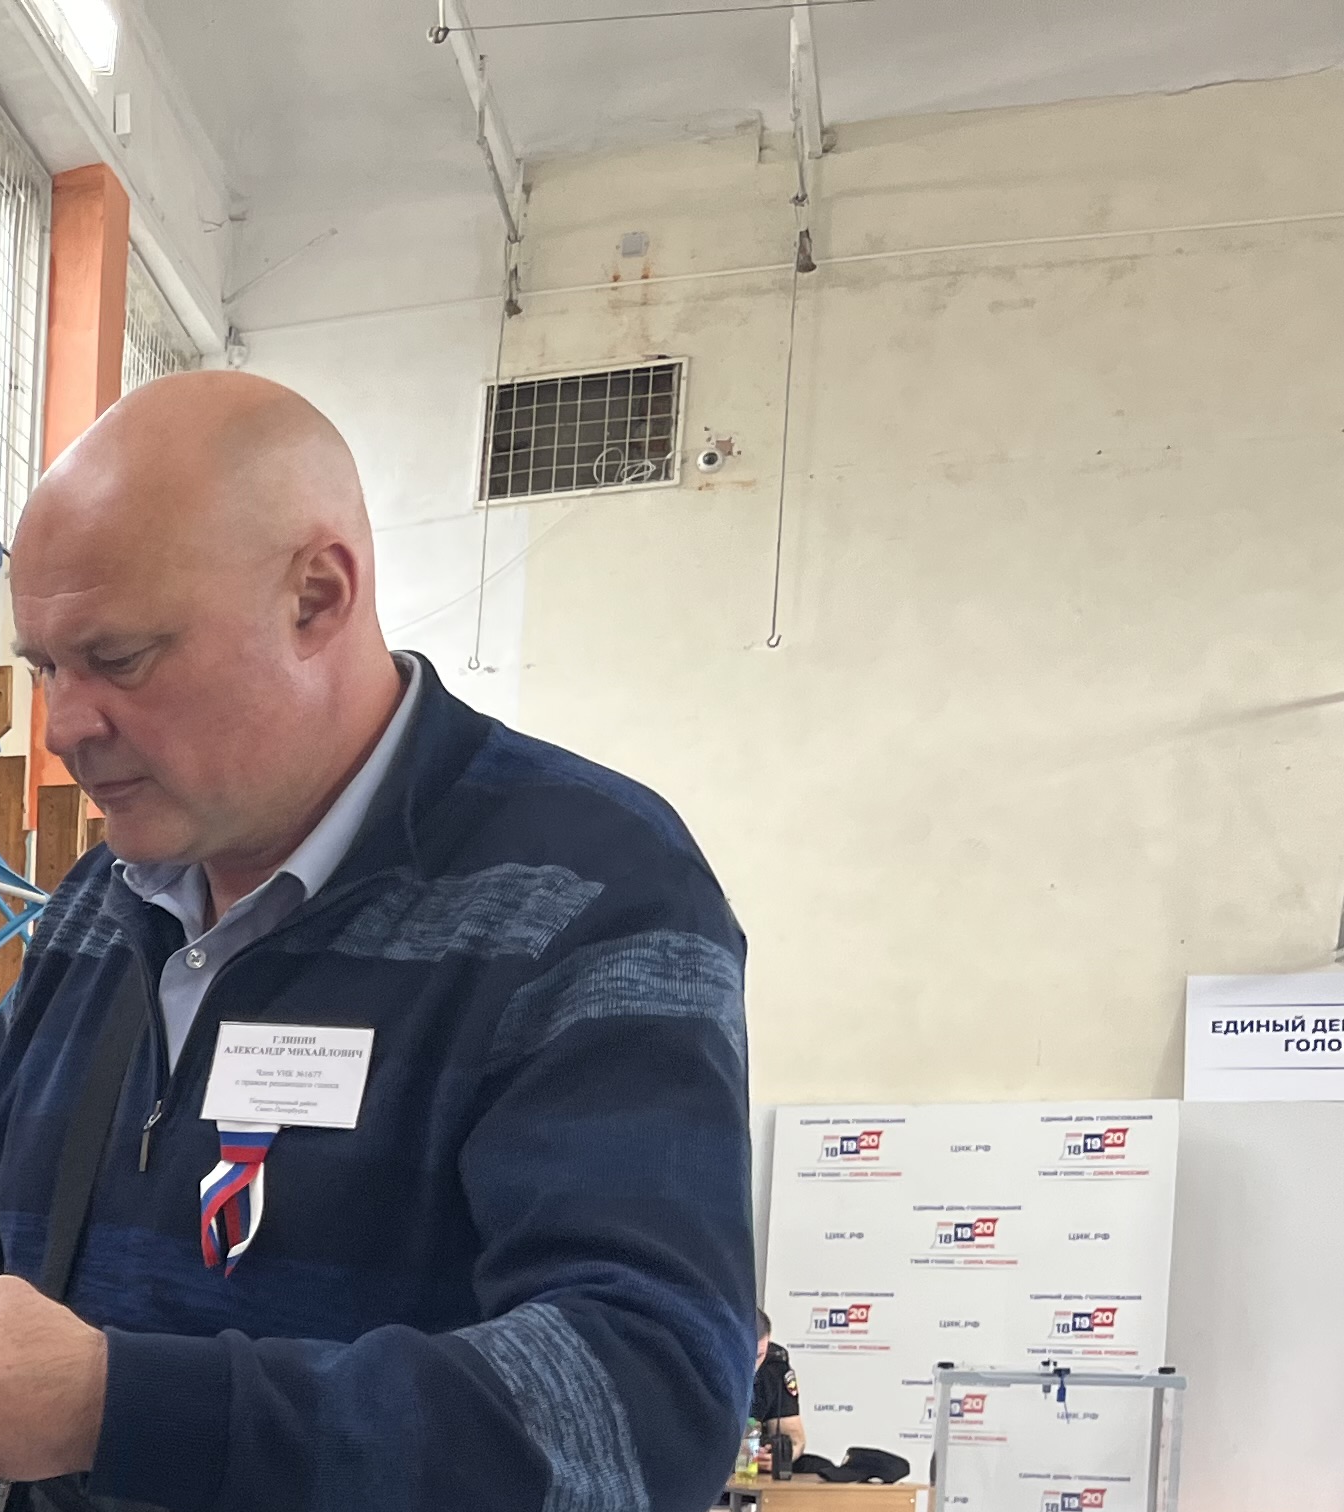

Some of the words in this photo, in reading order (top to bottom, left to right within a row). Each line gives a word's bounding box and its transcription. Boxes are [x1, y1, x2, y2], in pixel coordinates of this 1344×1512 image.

[1211, 1015, 1306, 1036] ЕДИНЫЙ
[1284, 1038, 1343, 1052] ГОЛО
[224, 1045, 286, 1056] АЛЕКСАНДР
[287, 1046, 363, 1059] МИХАЙЛОВИЧ
[860, 1135, 877, 1147] 20
[1105, 1132, 1124, 1144] 20
[974, 1221, 993, 1233] 20
[848, 1308, 867, 1320] 20
[1093, 1311, 1113, 1323] 20
[1082, 1492, 1102, 1504] 20
